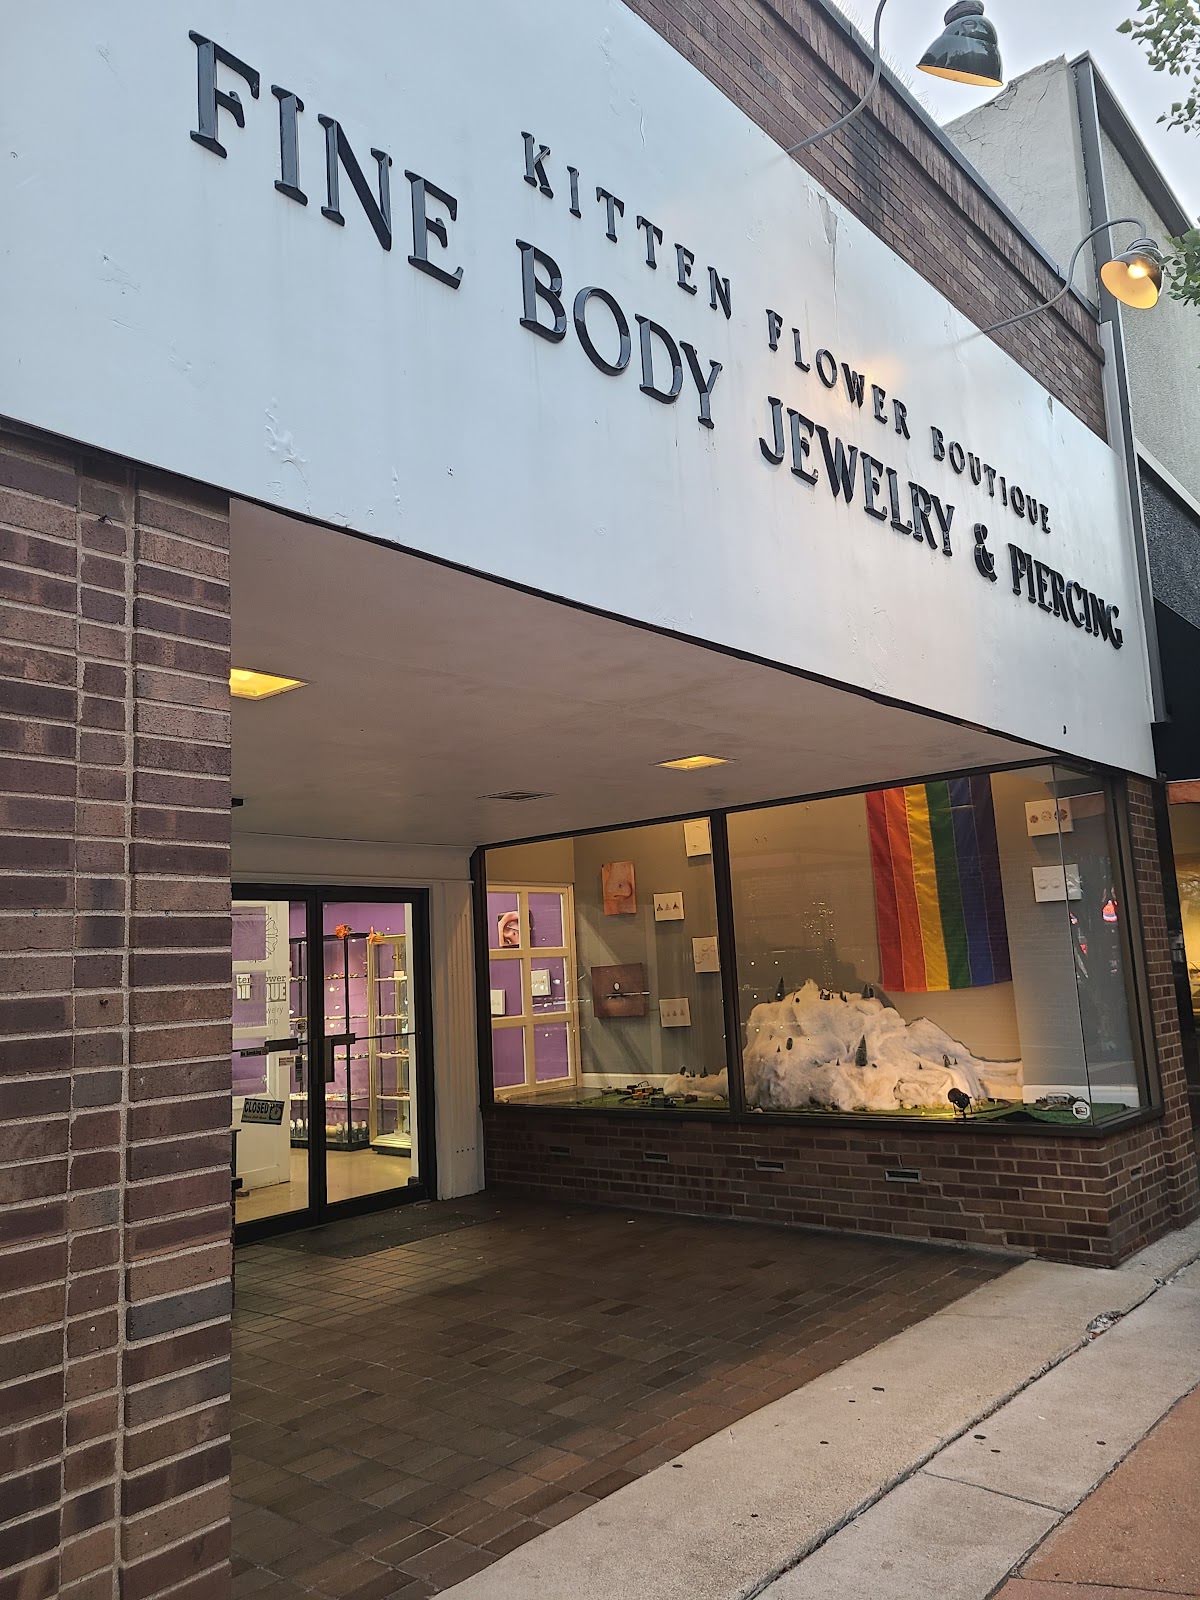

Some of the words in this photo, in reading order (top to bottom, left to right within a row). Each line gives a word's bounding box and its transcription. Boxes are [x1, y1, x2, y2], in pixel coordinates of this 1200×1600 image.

[188, 29, 464, 290] FINE
[515, 238, 722, 430] BODY
[758, 395, 955, 558] JEWELRY
[973, 522, 998, 582] &
[1007, 542, 1124, 650] PIERCING
[520, 130, 733, 320] KITTEN
[765, 308, 911, 440] FLOWER
[929, 425, 1052, 535] BOUTIQUE
[244, 1101, 269, 1114] CLOSED
